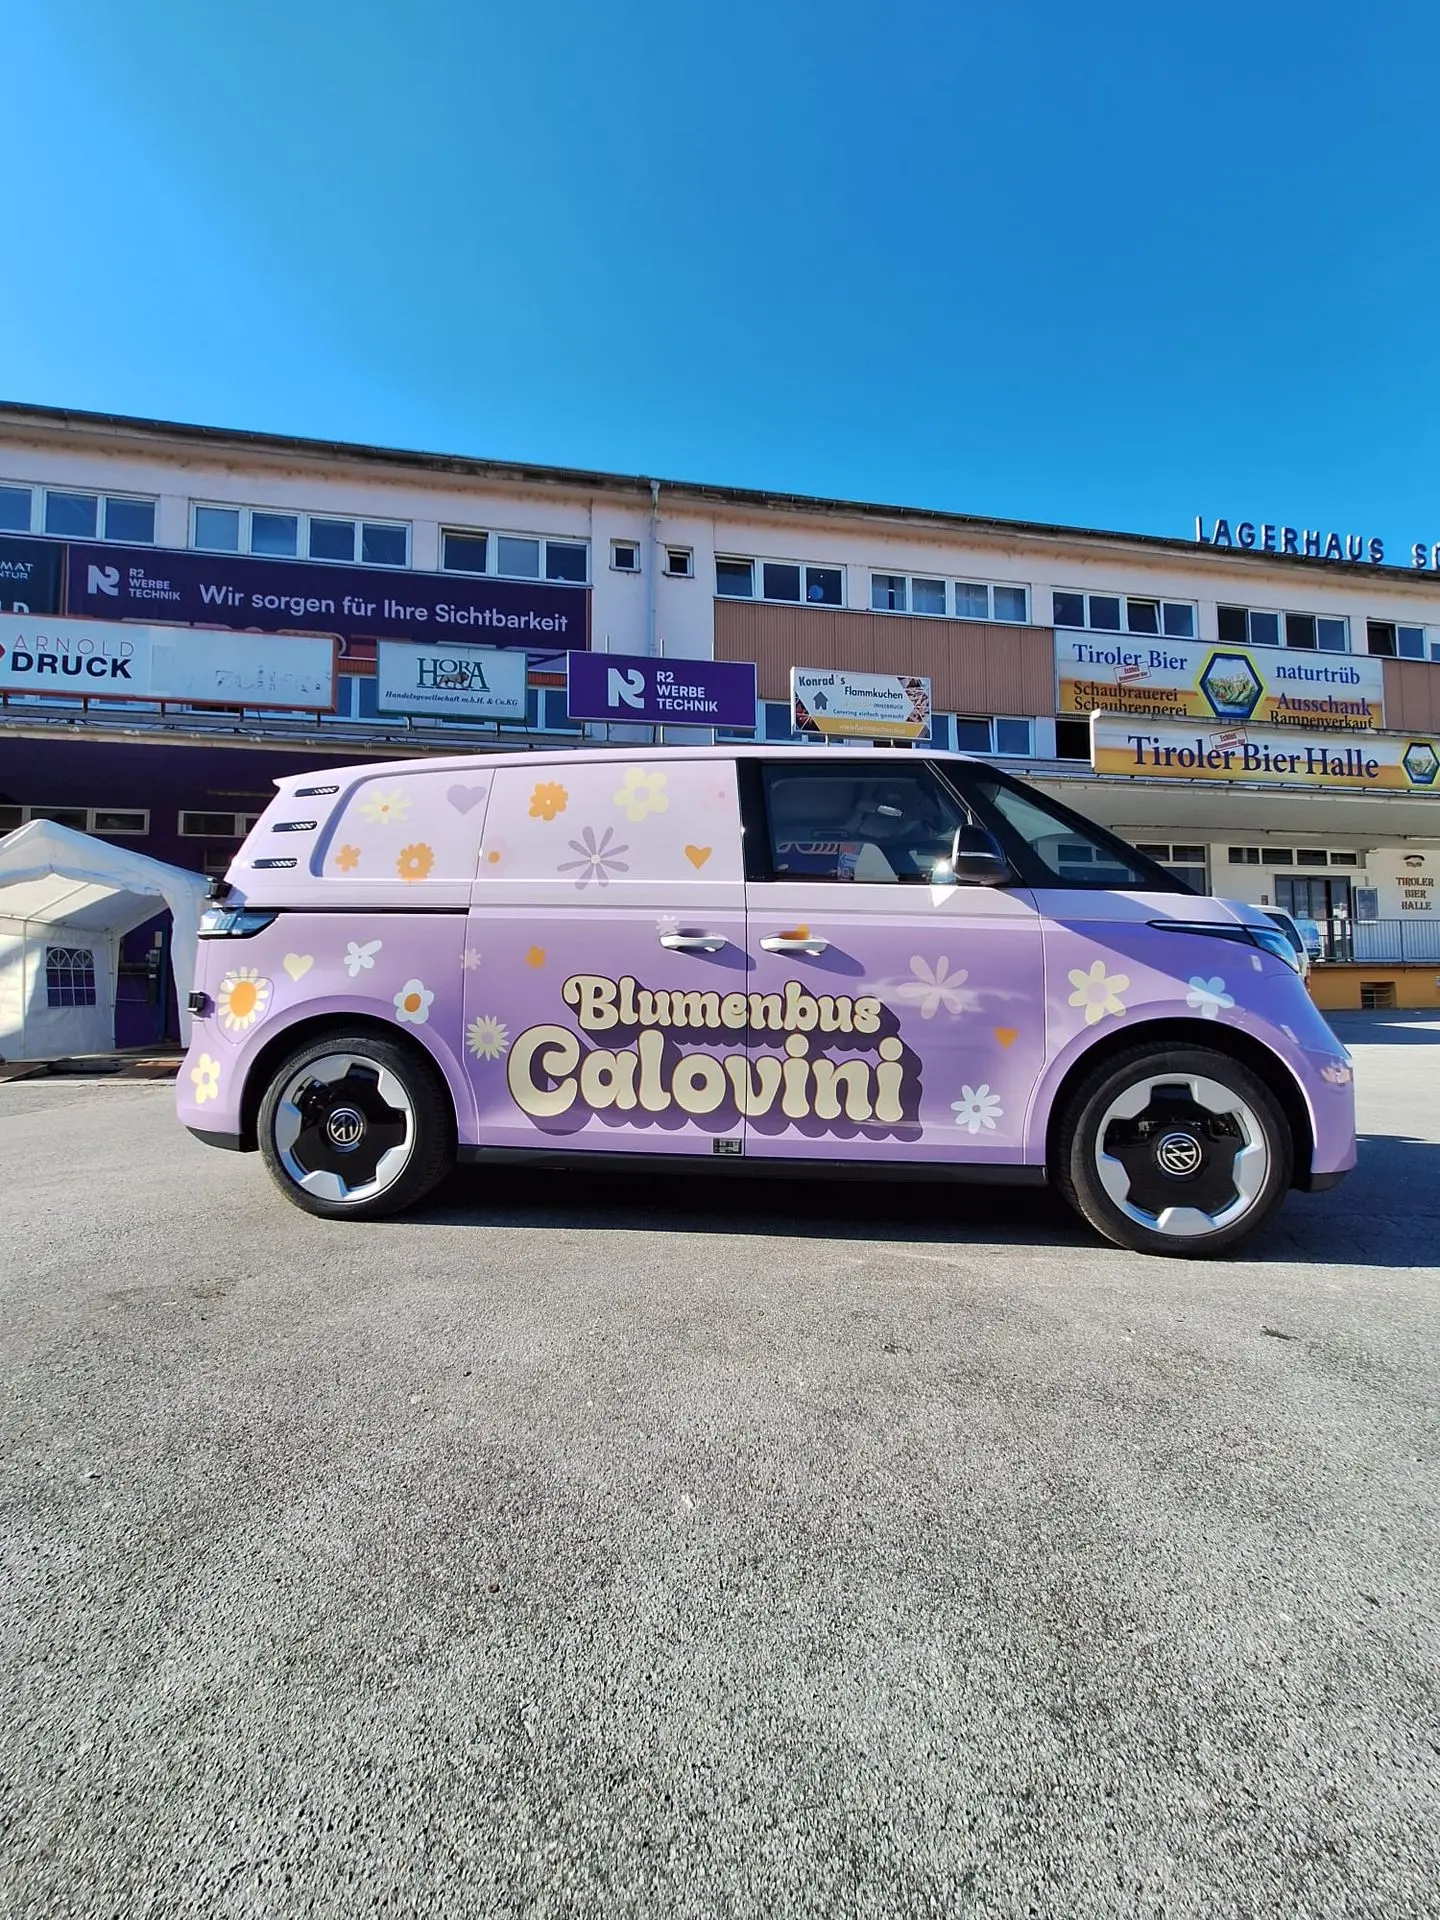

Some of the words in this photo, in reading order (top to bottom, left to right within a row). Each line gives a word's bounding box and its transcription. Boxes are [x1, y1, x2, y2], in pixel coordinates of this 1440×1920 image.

[1195, 515, 1384, 564] LAGERHAUS
[129, 568, 145, 577] R2
[129, 578, 170, 590] WERBE
[129, 587, 181, 601] TECHNIK
[200, 583, 244, 606] Wir
[252, 594, 335, 616] sorgen
[342, 596, 376, 617] für
[383, 599, 428, 621] Ihre
[435, 603, 568, 632] Sichtbarkeit
[14, 634, 135, 657] ARNOLD
[11, 651, 132, 679] DRUCK
[1072, 643, 1141, 666] Tiroler
[1148, 650, 1188, 670] Bier
[417, 657, 490, 689] HORA
[657, 671, 674, 683] R2
[1276, 665, 1361, 685] naturtrüb
[385, 690, 460, 703] Handelsgesellschaft
[657, 684, 705, 698] WERBE
[845, 686, 903, 700] Flammkuchen
[1073, 680, 1178, 702] Schaubrauerei
[657, 697, 718, 713] TECHNIK
[1074, 696, 1187, 716] Schaubrennerei
[1276, 692, 1373, 716] Ausschank
[1127, 735, 1235, 770] Tiroler
[1241, 743, 1300, 774] Bier
[1304, 747, 1379, 778] Halle
[1395, 877, 1434, 888] TIROLER
[1405, 889, 1427, 899] BIER
[1401, 901, 1432, 911] HALLE
[561, 973, 883, 1035] Blumenbus
[506, 1022, 904, 1123] Calovini
